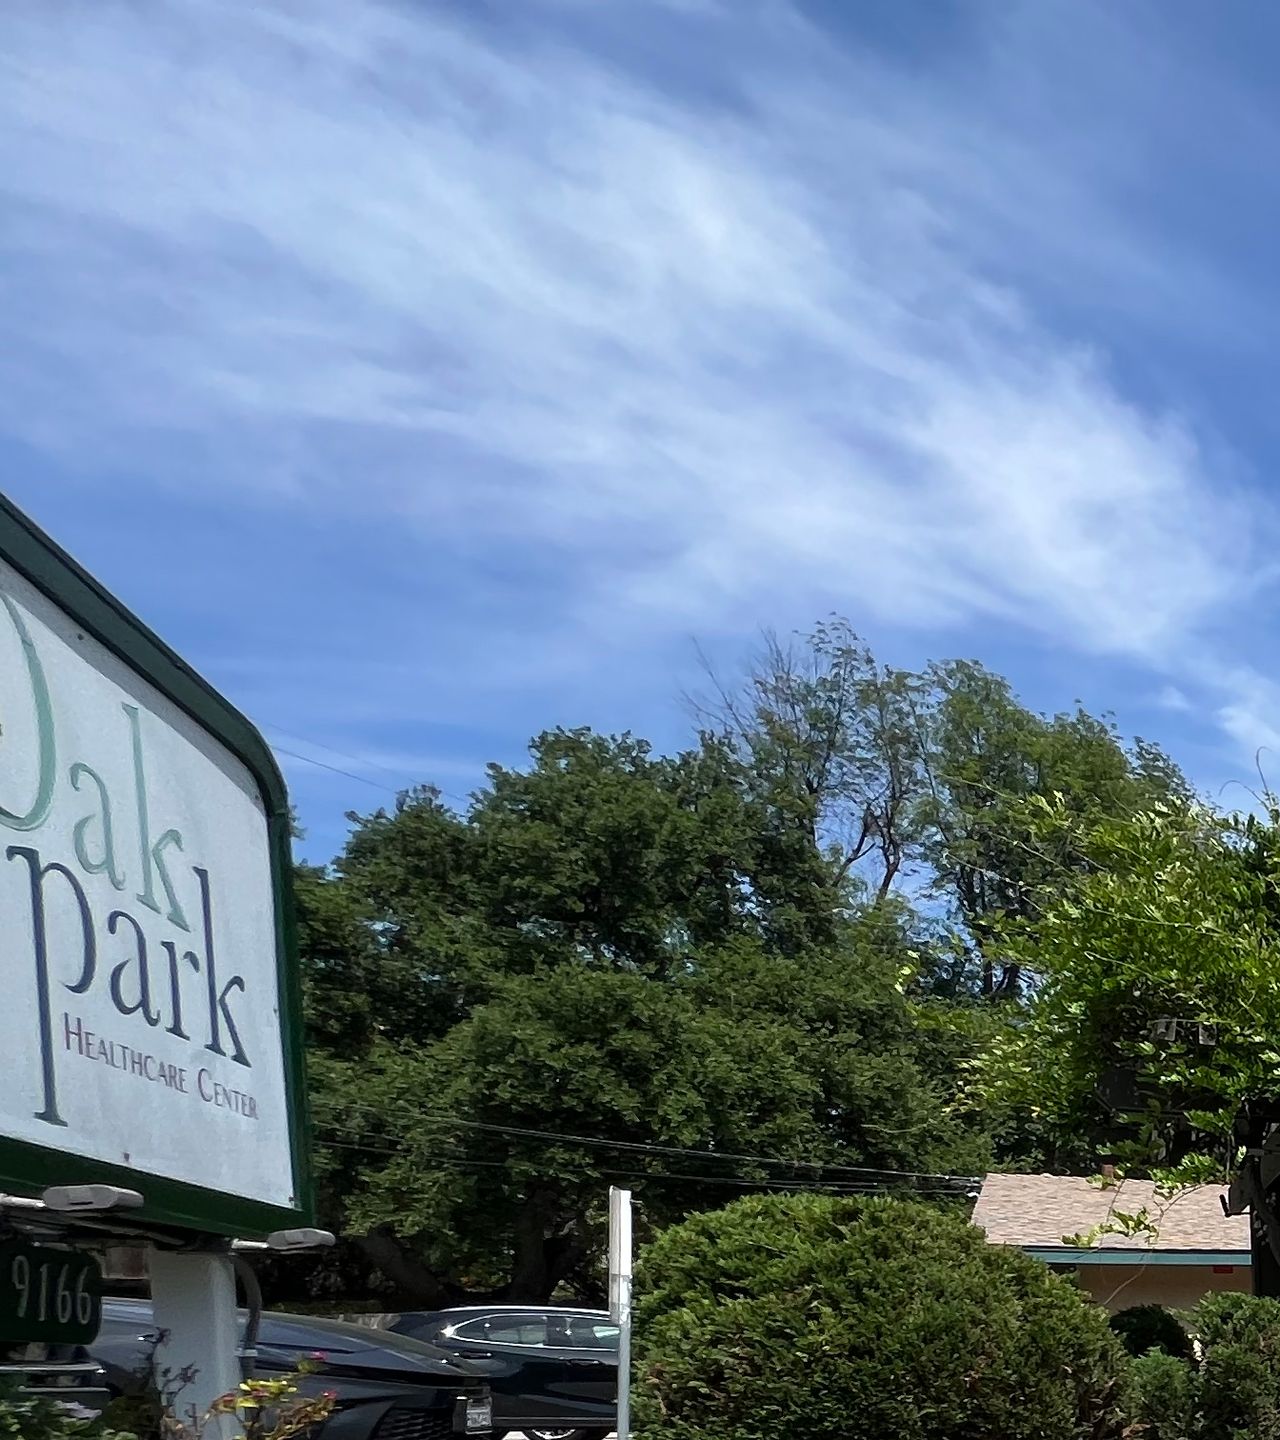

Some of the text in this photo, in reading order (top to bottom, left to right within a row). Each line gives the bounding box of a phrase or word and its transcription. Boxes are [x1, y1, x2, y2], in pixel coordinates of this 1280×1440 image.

[6, 845, 252, 1128] park
[64, 1012, 259, 1120] HEALTHCARE CENTER
[12, 1254, 93, 1325] 9166
